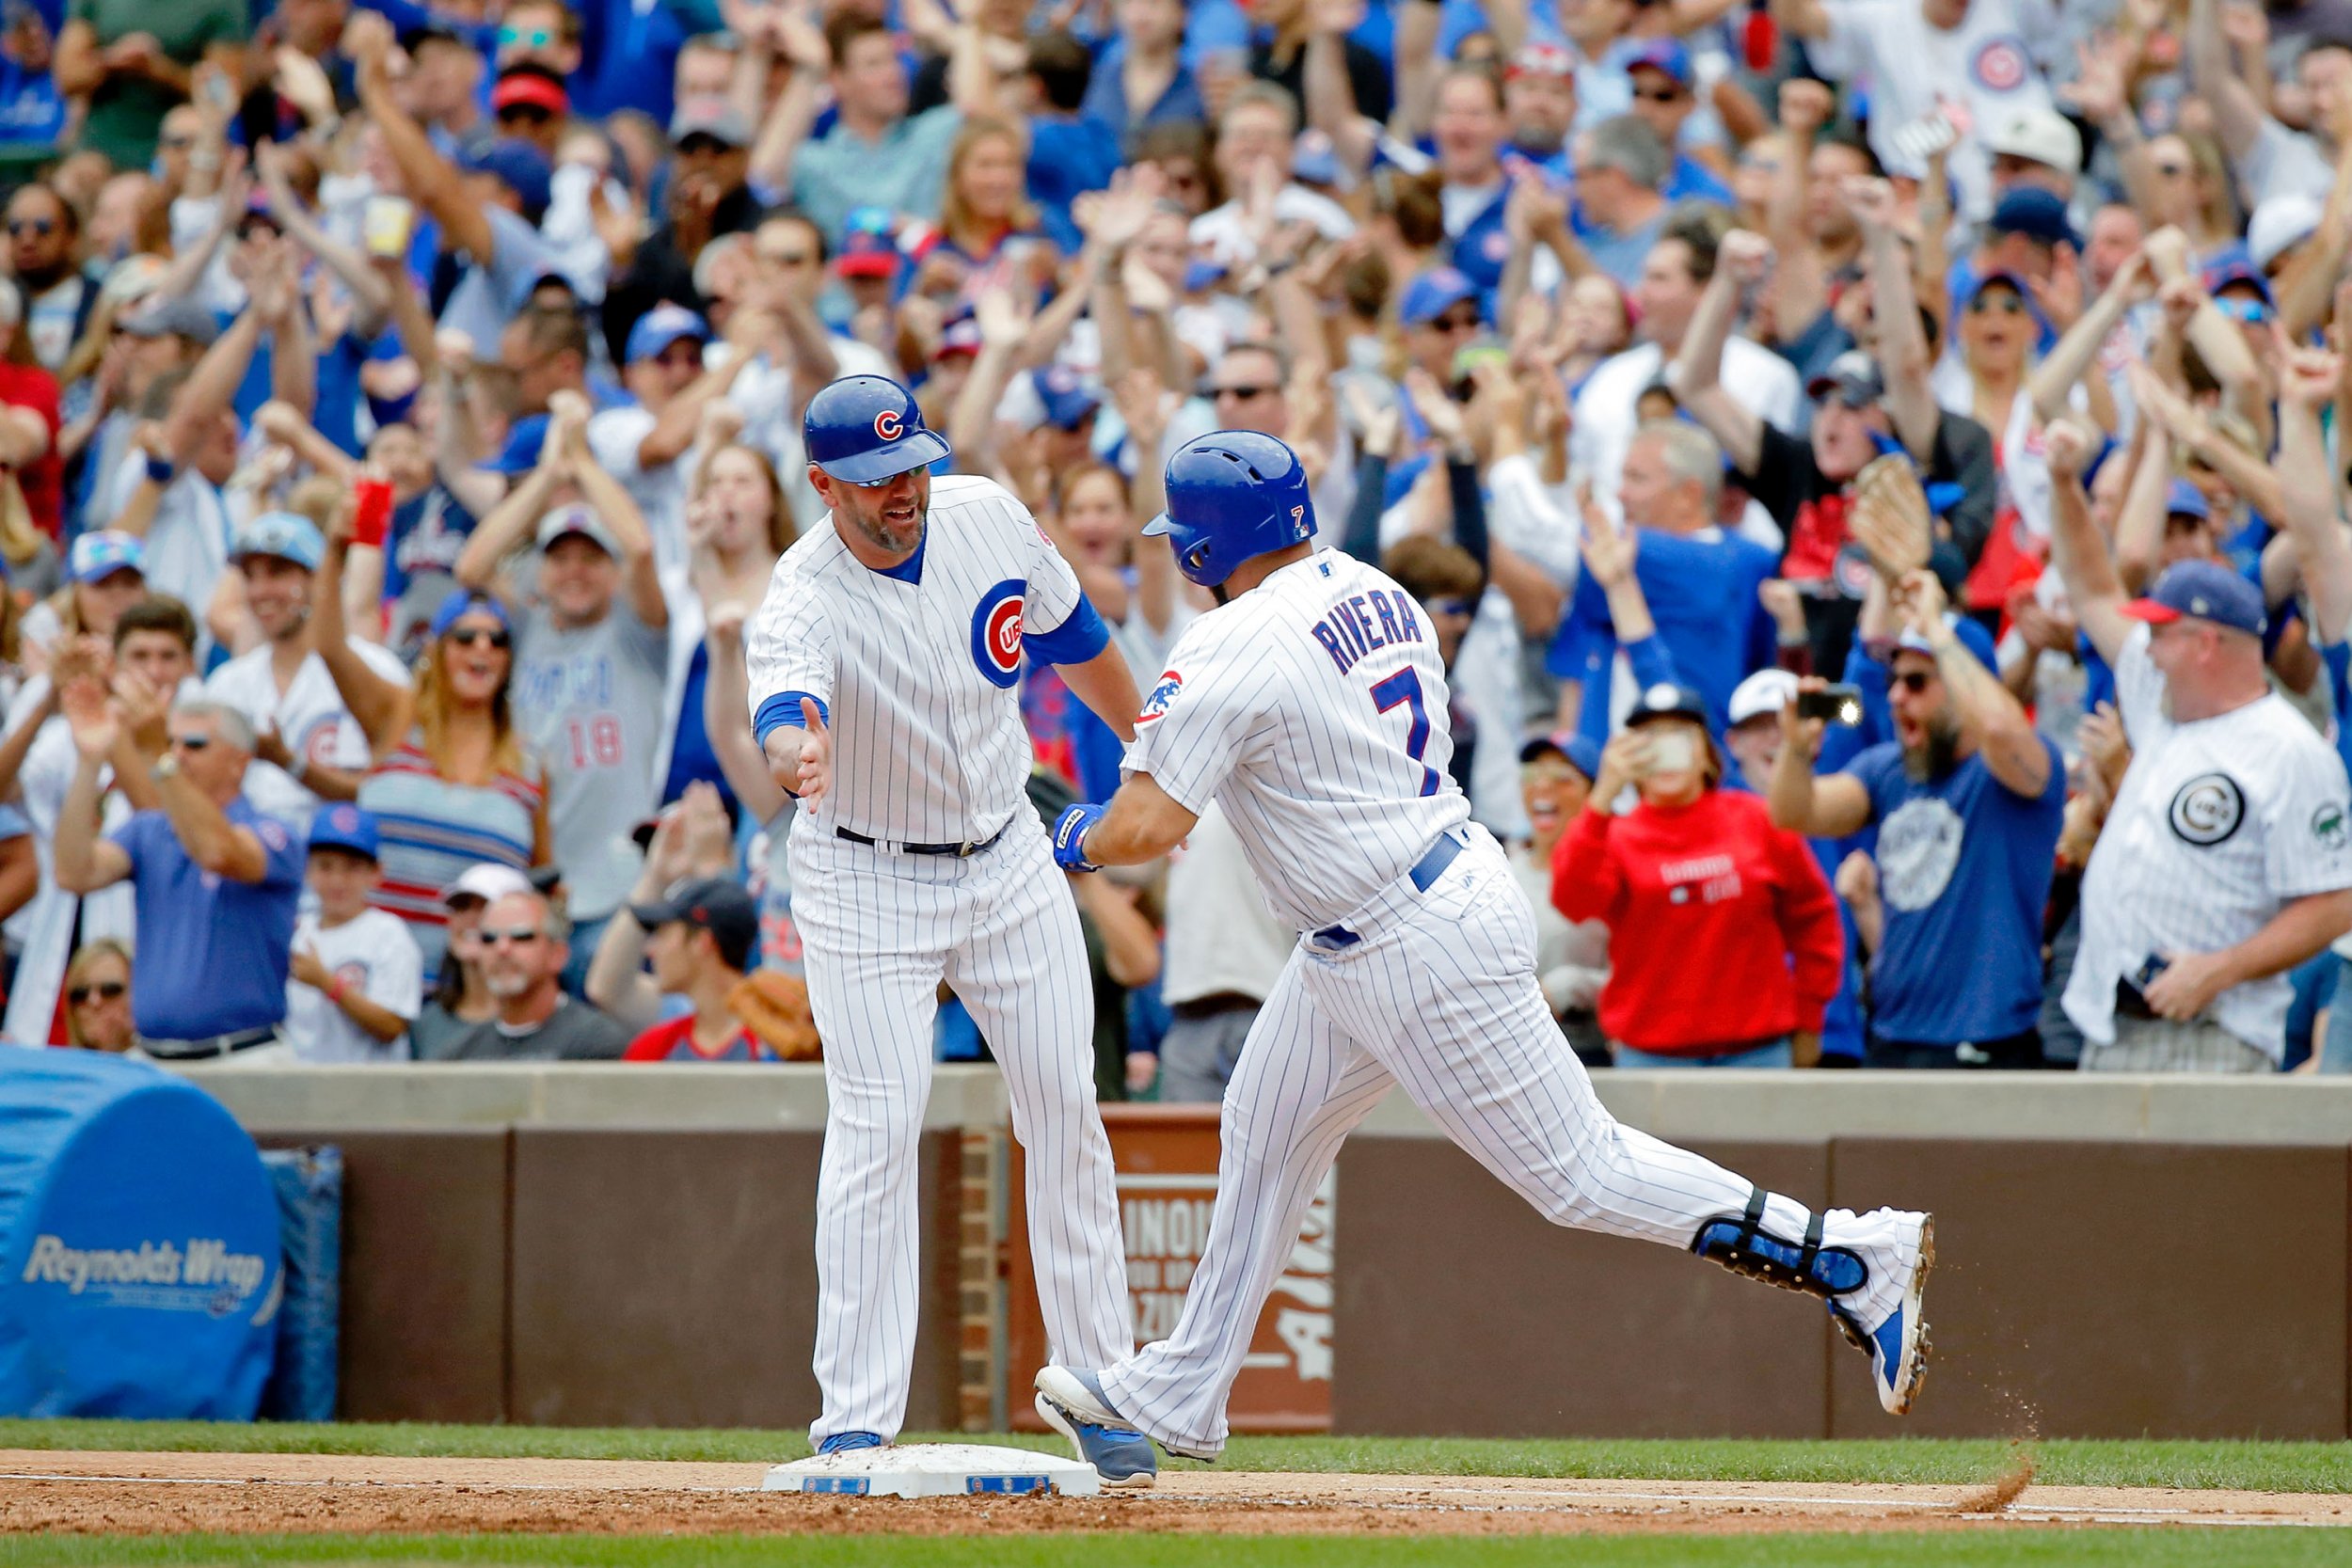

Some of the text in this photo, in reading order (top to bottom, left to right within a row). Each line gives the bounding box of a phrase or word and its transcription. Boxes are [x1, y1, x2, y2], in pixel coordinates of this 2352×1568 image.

[874, 410, 903, 441] C
[1291, 504, 1305, 528] 7
[1311, 589, 1422, 676] RIVERA
[1369, 664, 1440, 797] 7
[23, 1234, 264, 1298] Reynolds Wrap
